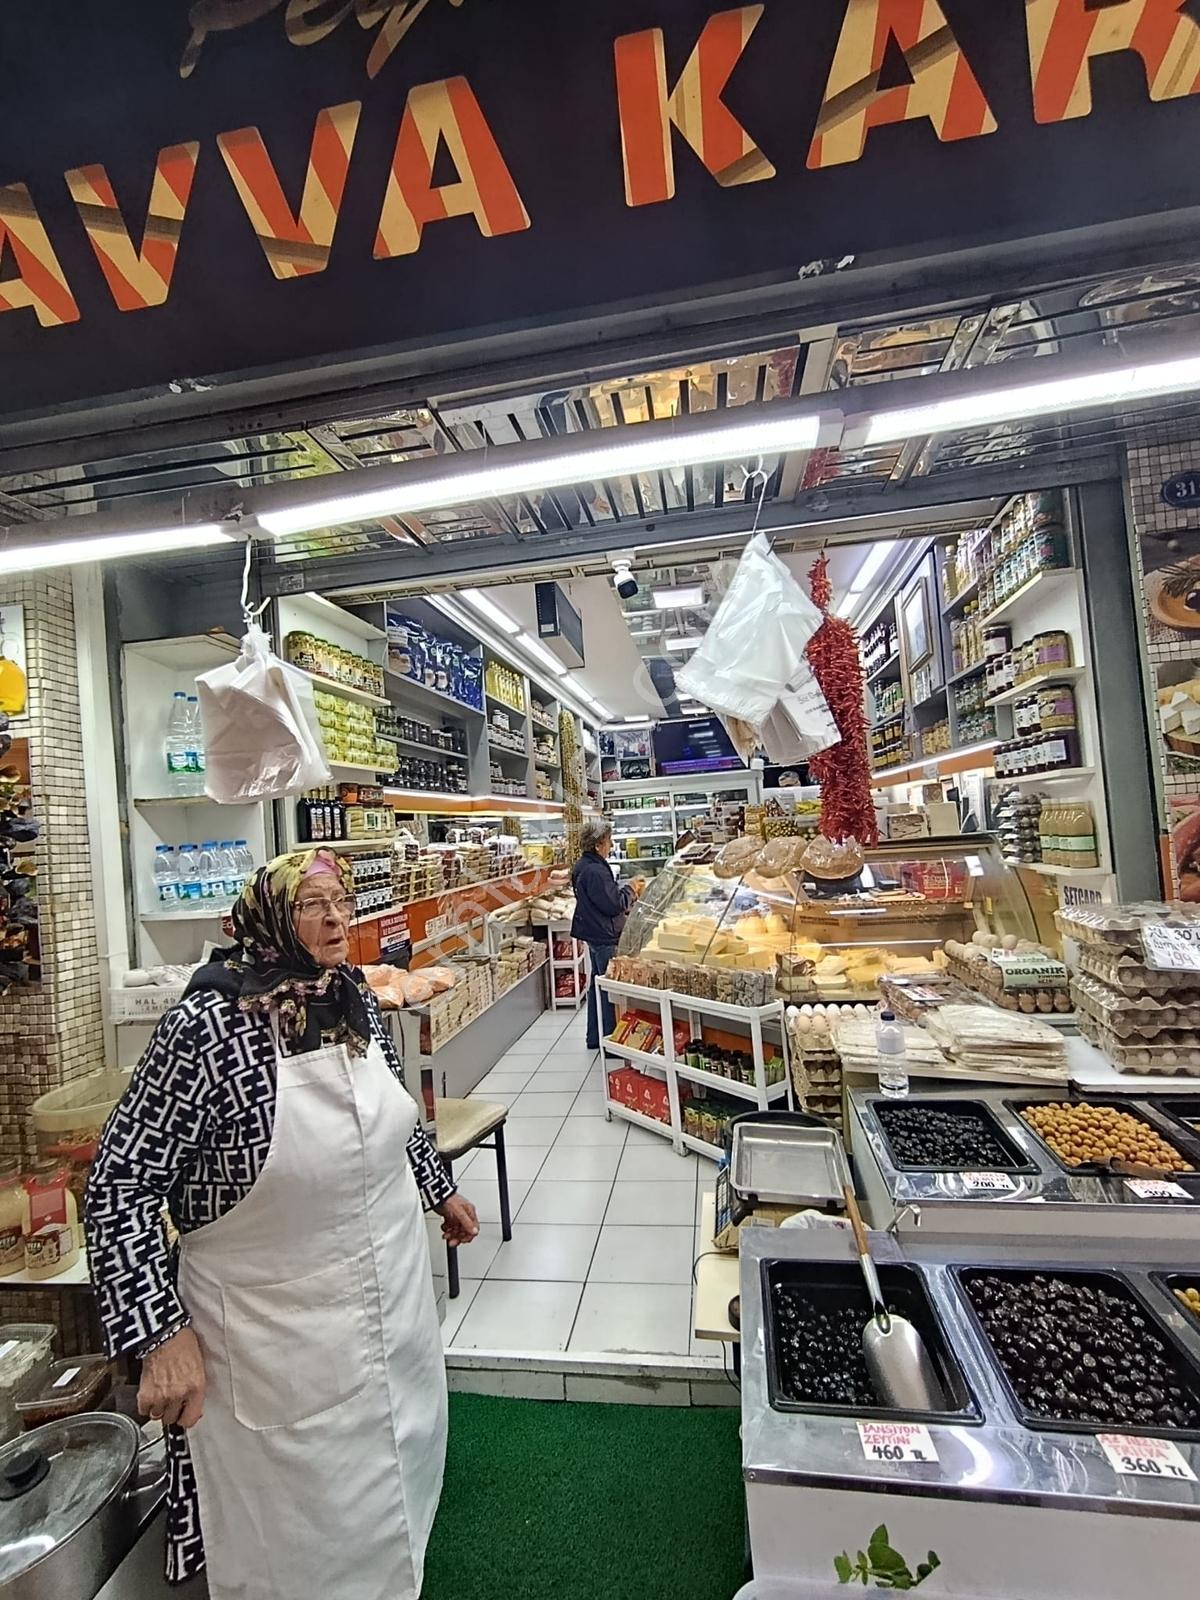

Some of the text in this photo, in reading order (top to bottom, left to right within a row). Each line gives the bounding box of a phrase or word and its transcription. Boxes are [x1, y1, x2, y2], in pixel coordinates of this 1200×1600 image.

[872, 1444, 904, 1460] 460
[1121, 1456, 1189, 1478] 360 TL
